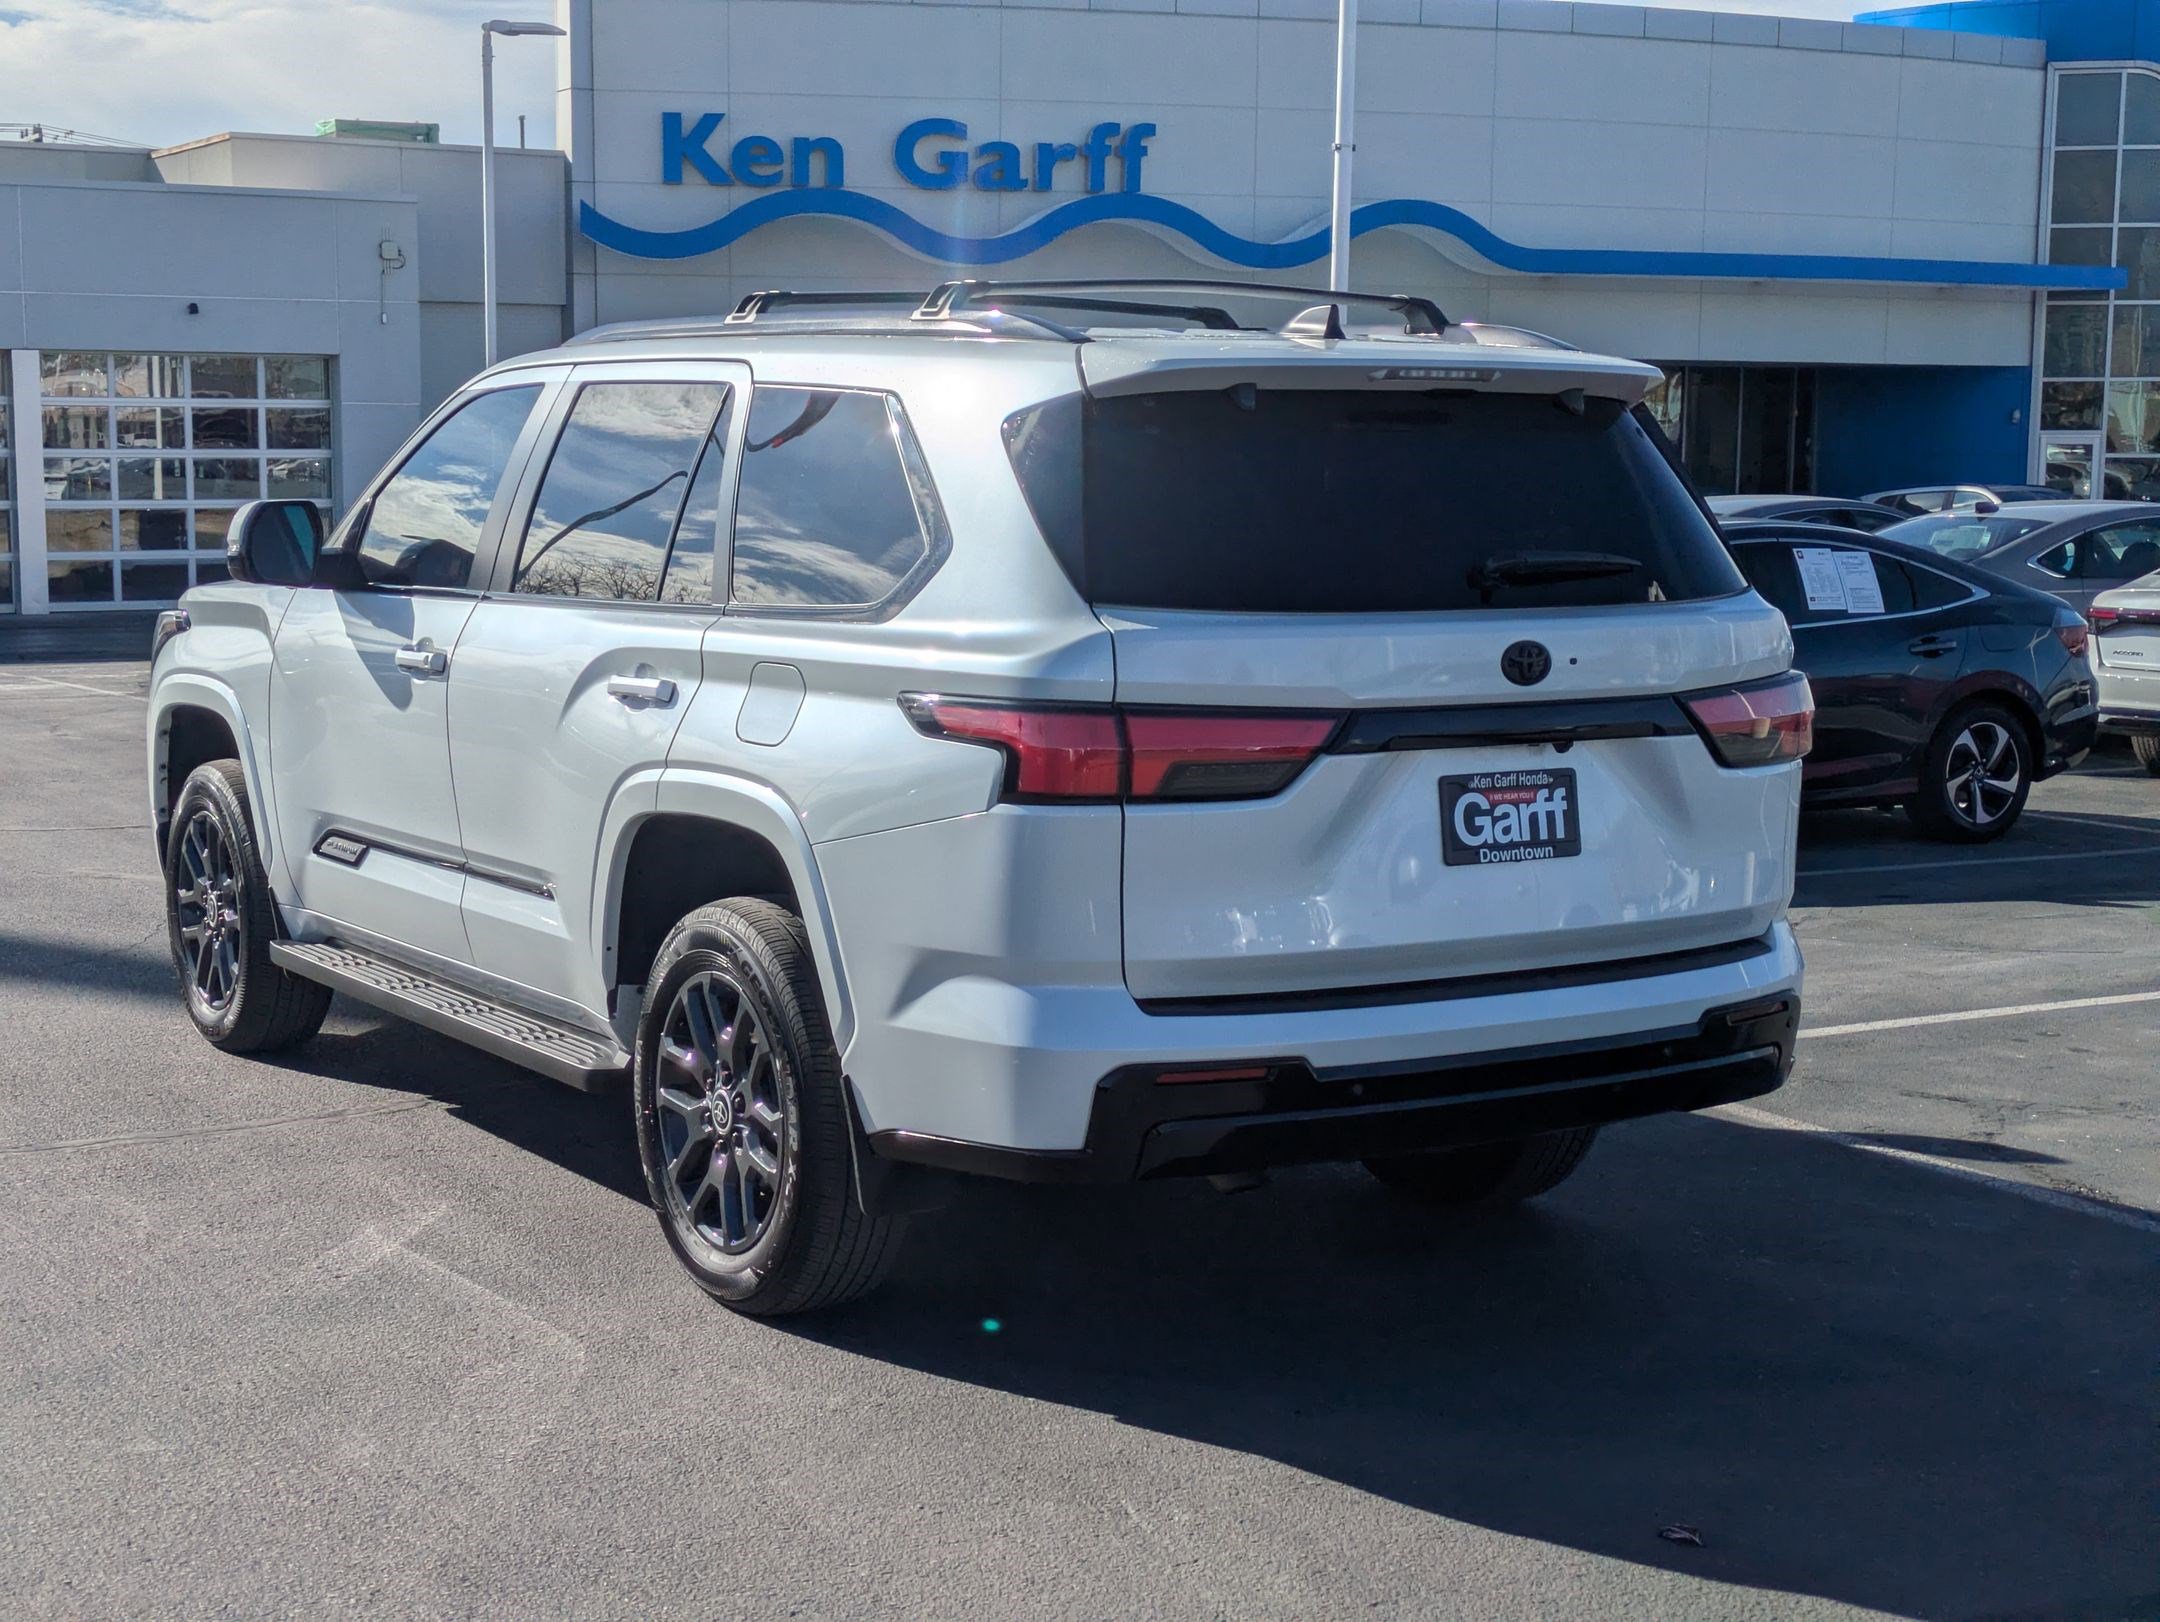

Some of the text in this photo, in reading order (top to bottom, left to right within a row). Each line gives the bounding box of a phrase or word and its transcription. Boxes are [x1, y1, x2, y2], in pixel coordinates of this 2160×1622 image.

[661, 111, 1157, 193] Ken Garff
[1473, 771, 1548, 789] Ken Garff Honda
[1454, 787, 1568, 847] Garff
[1480, 846, 1554, 863] Downtown
